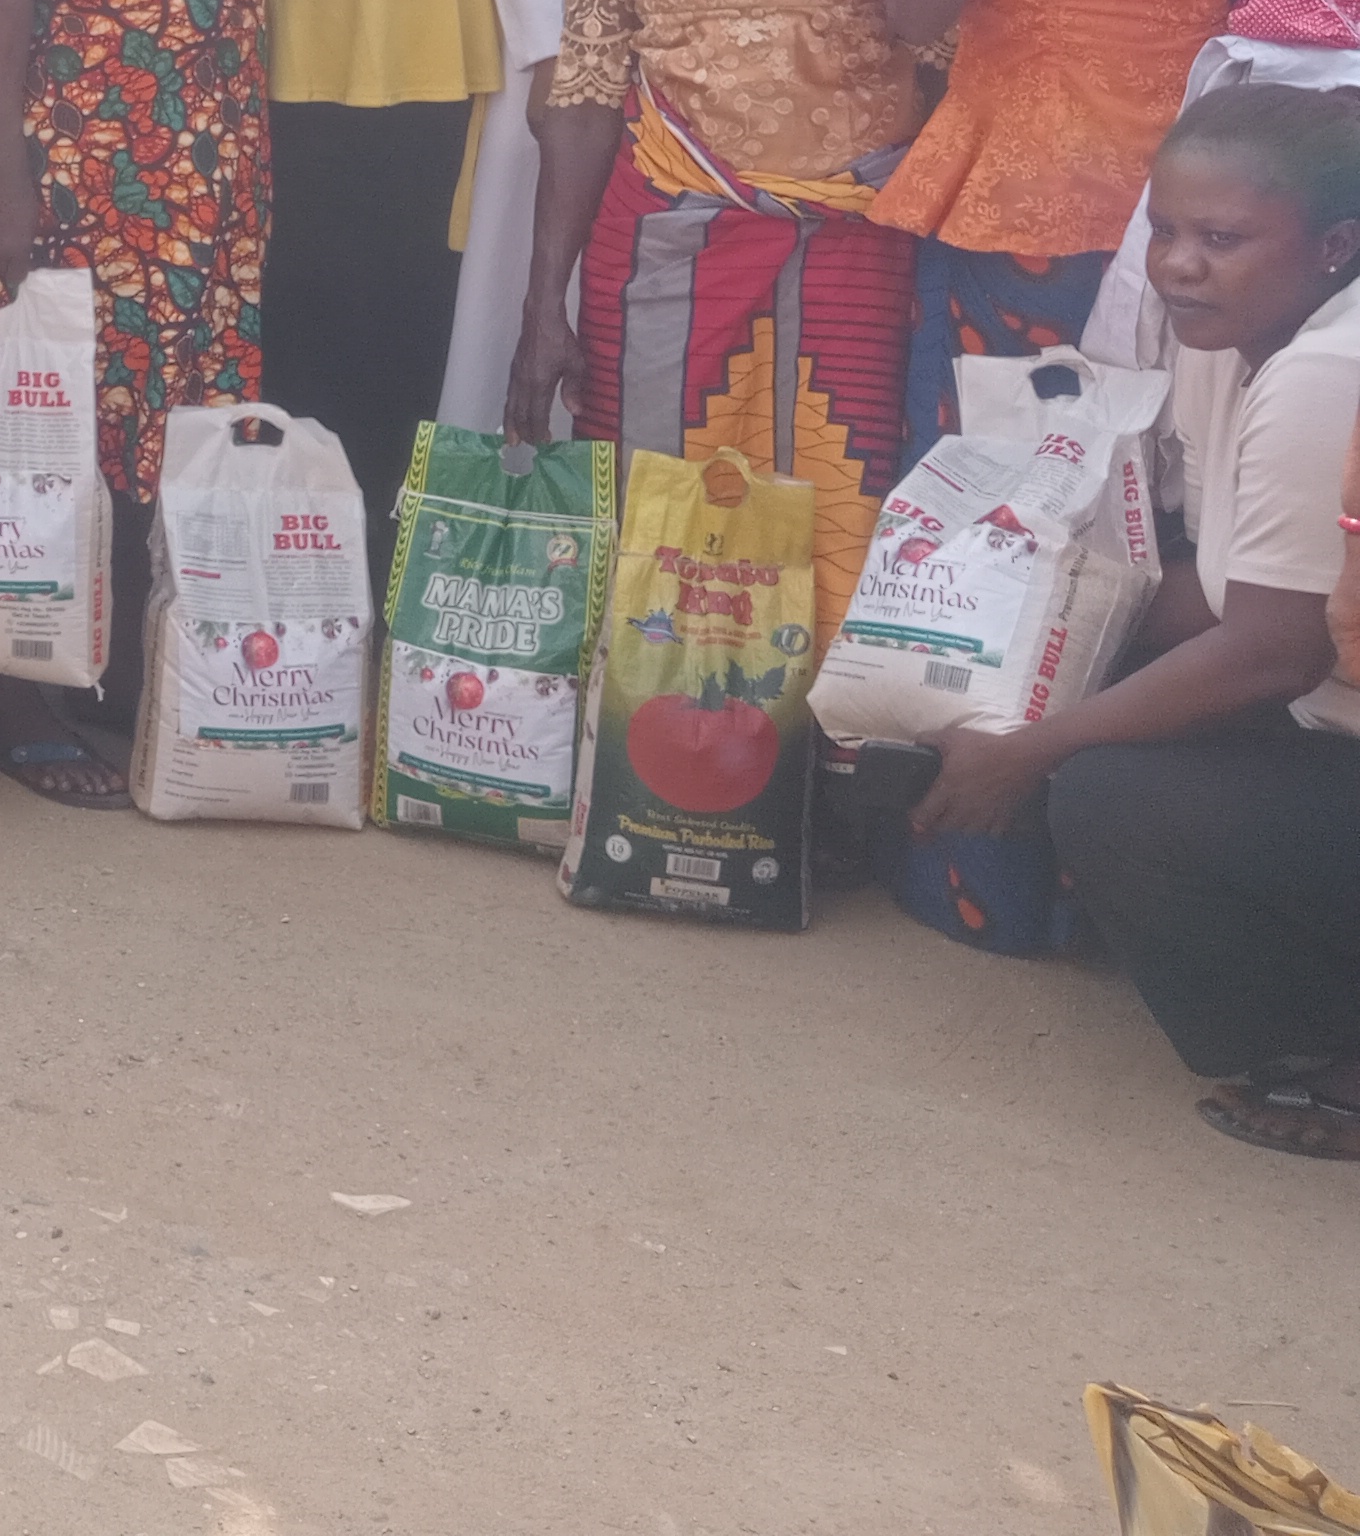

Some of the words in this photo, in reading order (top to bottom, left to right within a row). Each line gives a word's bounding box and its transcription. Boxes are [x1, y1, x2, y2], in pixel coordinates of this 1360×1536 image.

[17, 370, 60, 389] BIG
[7, 389, 71, 408] BULL
[1123, 461, 1139, 503] BIG
[281, 514, 330, 532] BIG
[887, 497, 944, 533] BIG
[273, 533, 341, 552] BULL
[1124, 507, 1147, 565] BULL
[880, 550, 966, 587] Merry
[423, 573, 563, 622] MAMA'S
[859, 574, 979, 612] Christmas
[434, 610, 541, 656] PRIDE
[231, 662, 317, 690] Merry
[1024, 680, 1050, 722] BIG
[1037, 627, 1068, 681] BULL
[212, 685, 334, 709] Christmas
[433, 695, 523, 741] Merry
[413, 714, 539, 762] Christmas
[617, 814, 680, 842] Premium
[681, 828, 746, 850] Parboiled
